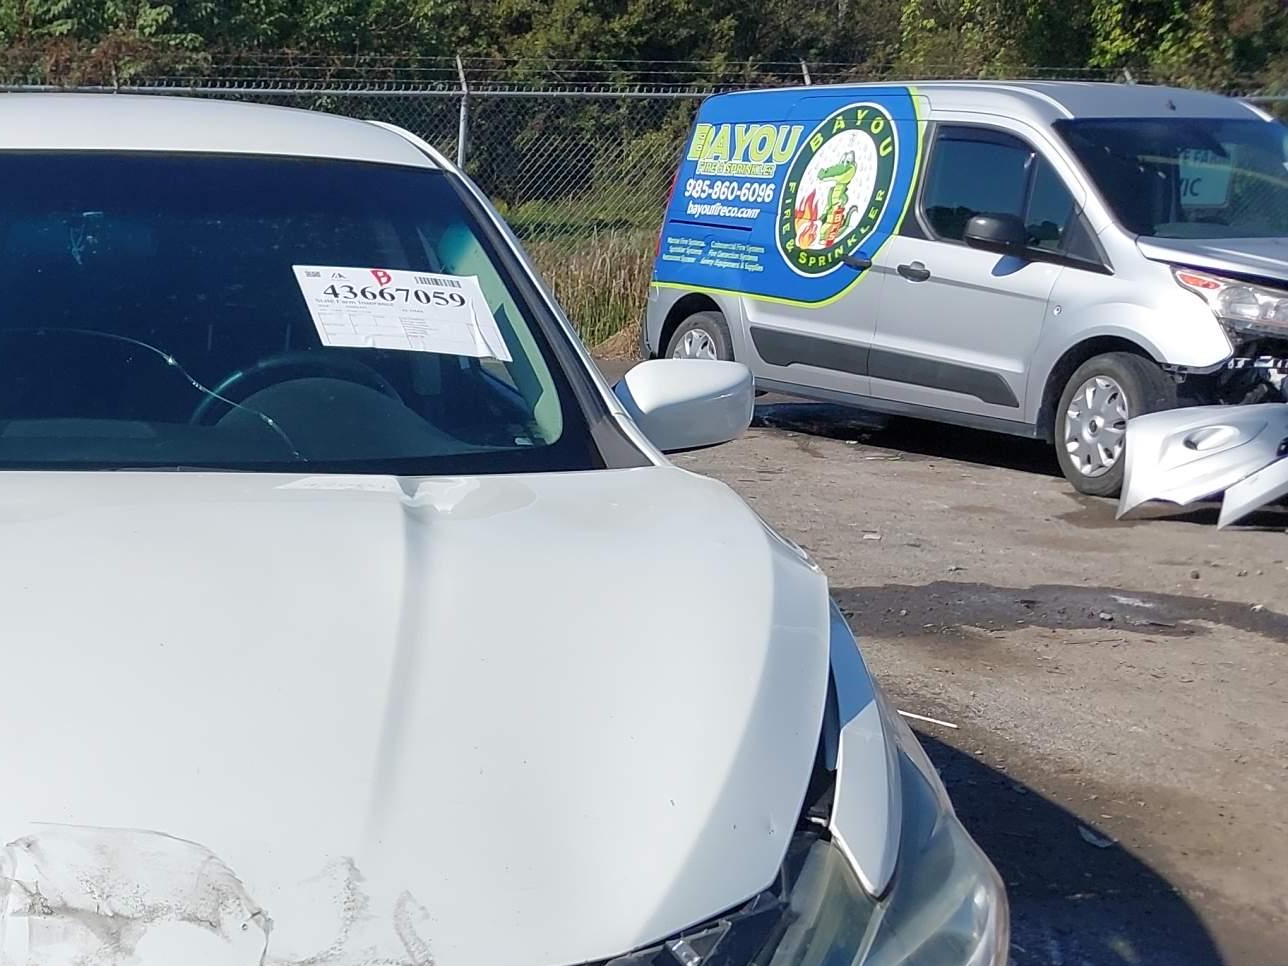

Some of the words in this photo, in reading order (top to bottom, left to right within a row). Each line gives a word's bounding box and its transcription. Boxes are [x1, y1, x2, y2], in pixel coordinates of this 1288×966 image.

[687, 124, 803, 163] BAYOU
[809, 108, 894, 158] BAYOU
[684, 180, 775, 202] 985-860-6096
[687, 203, 760, 218] bayoufireco.com
[798, 189, 885, 267] SPRINKLER
[323, 284, 465, 307] 43667059
